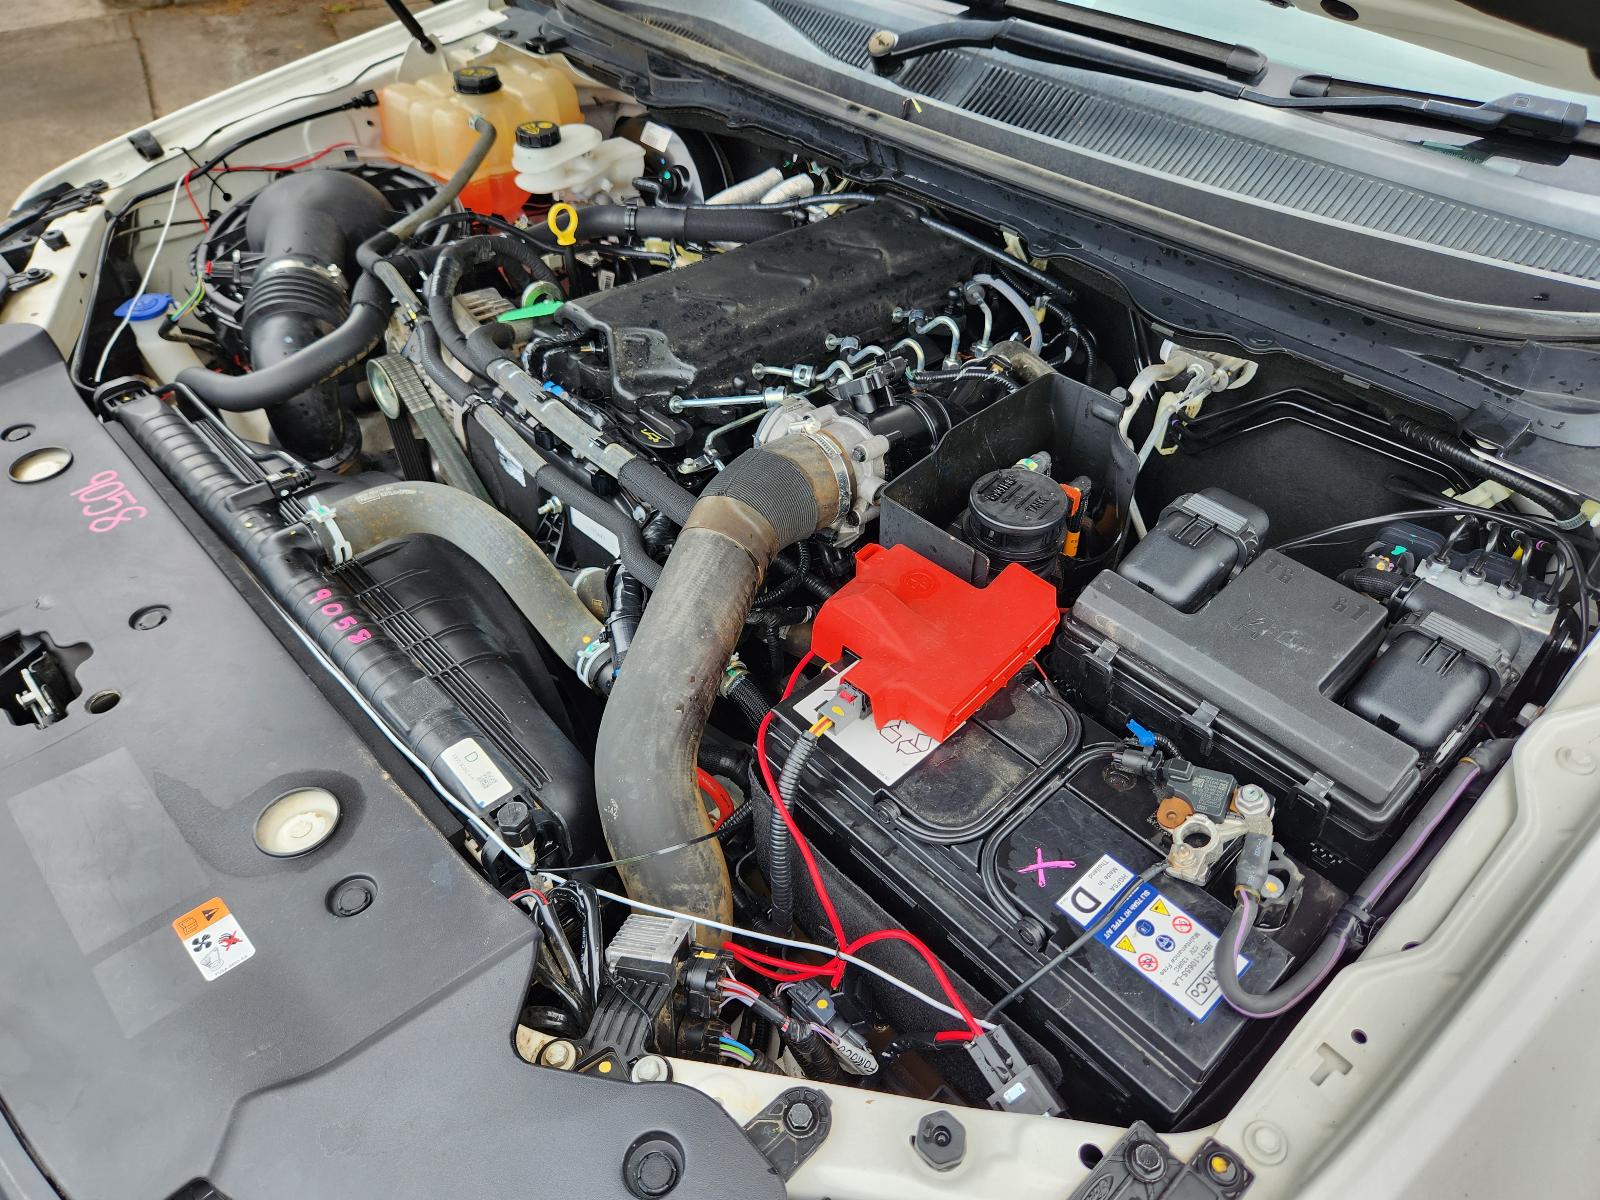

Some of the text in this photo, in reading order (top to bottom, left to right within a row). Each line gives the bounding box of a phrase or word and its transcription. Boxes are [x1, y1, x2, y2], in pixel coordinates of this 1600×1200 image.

[1088, 858, 1109, 880] Thailand
[1103, 866, 1119, 882] Made
[1071, 886, 1102, 914] D
[1108, 914, 1126, 931] TYPE
[1188, 969, 1218, 999] MoCo
